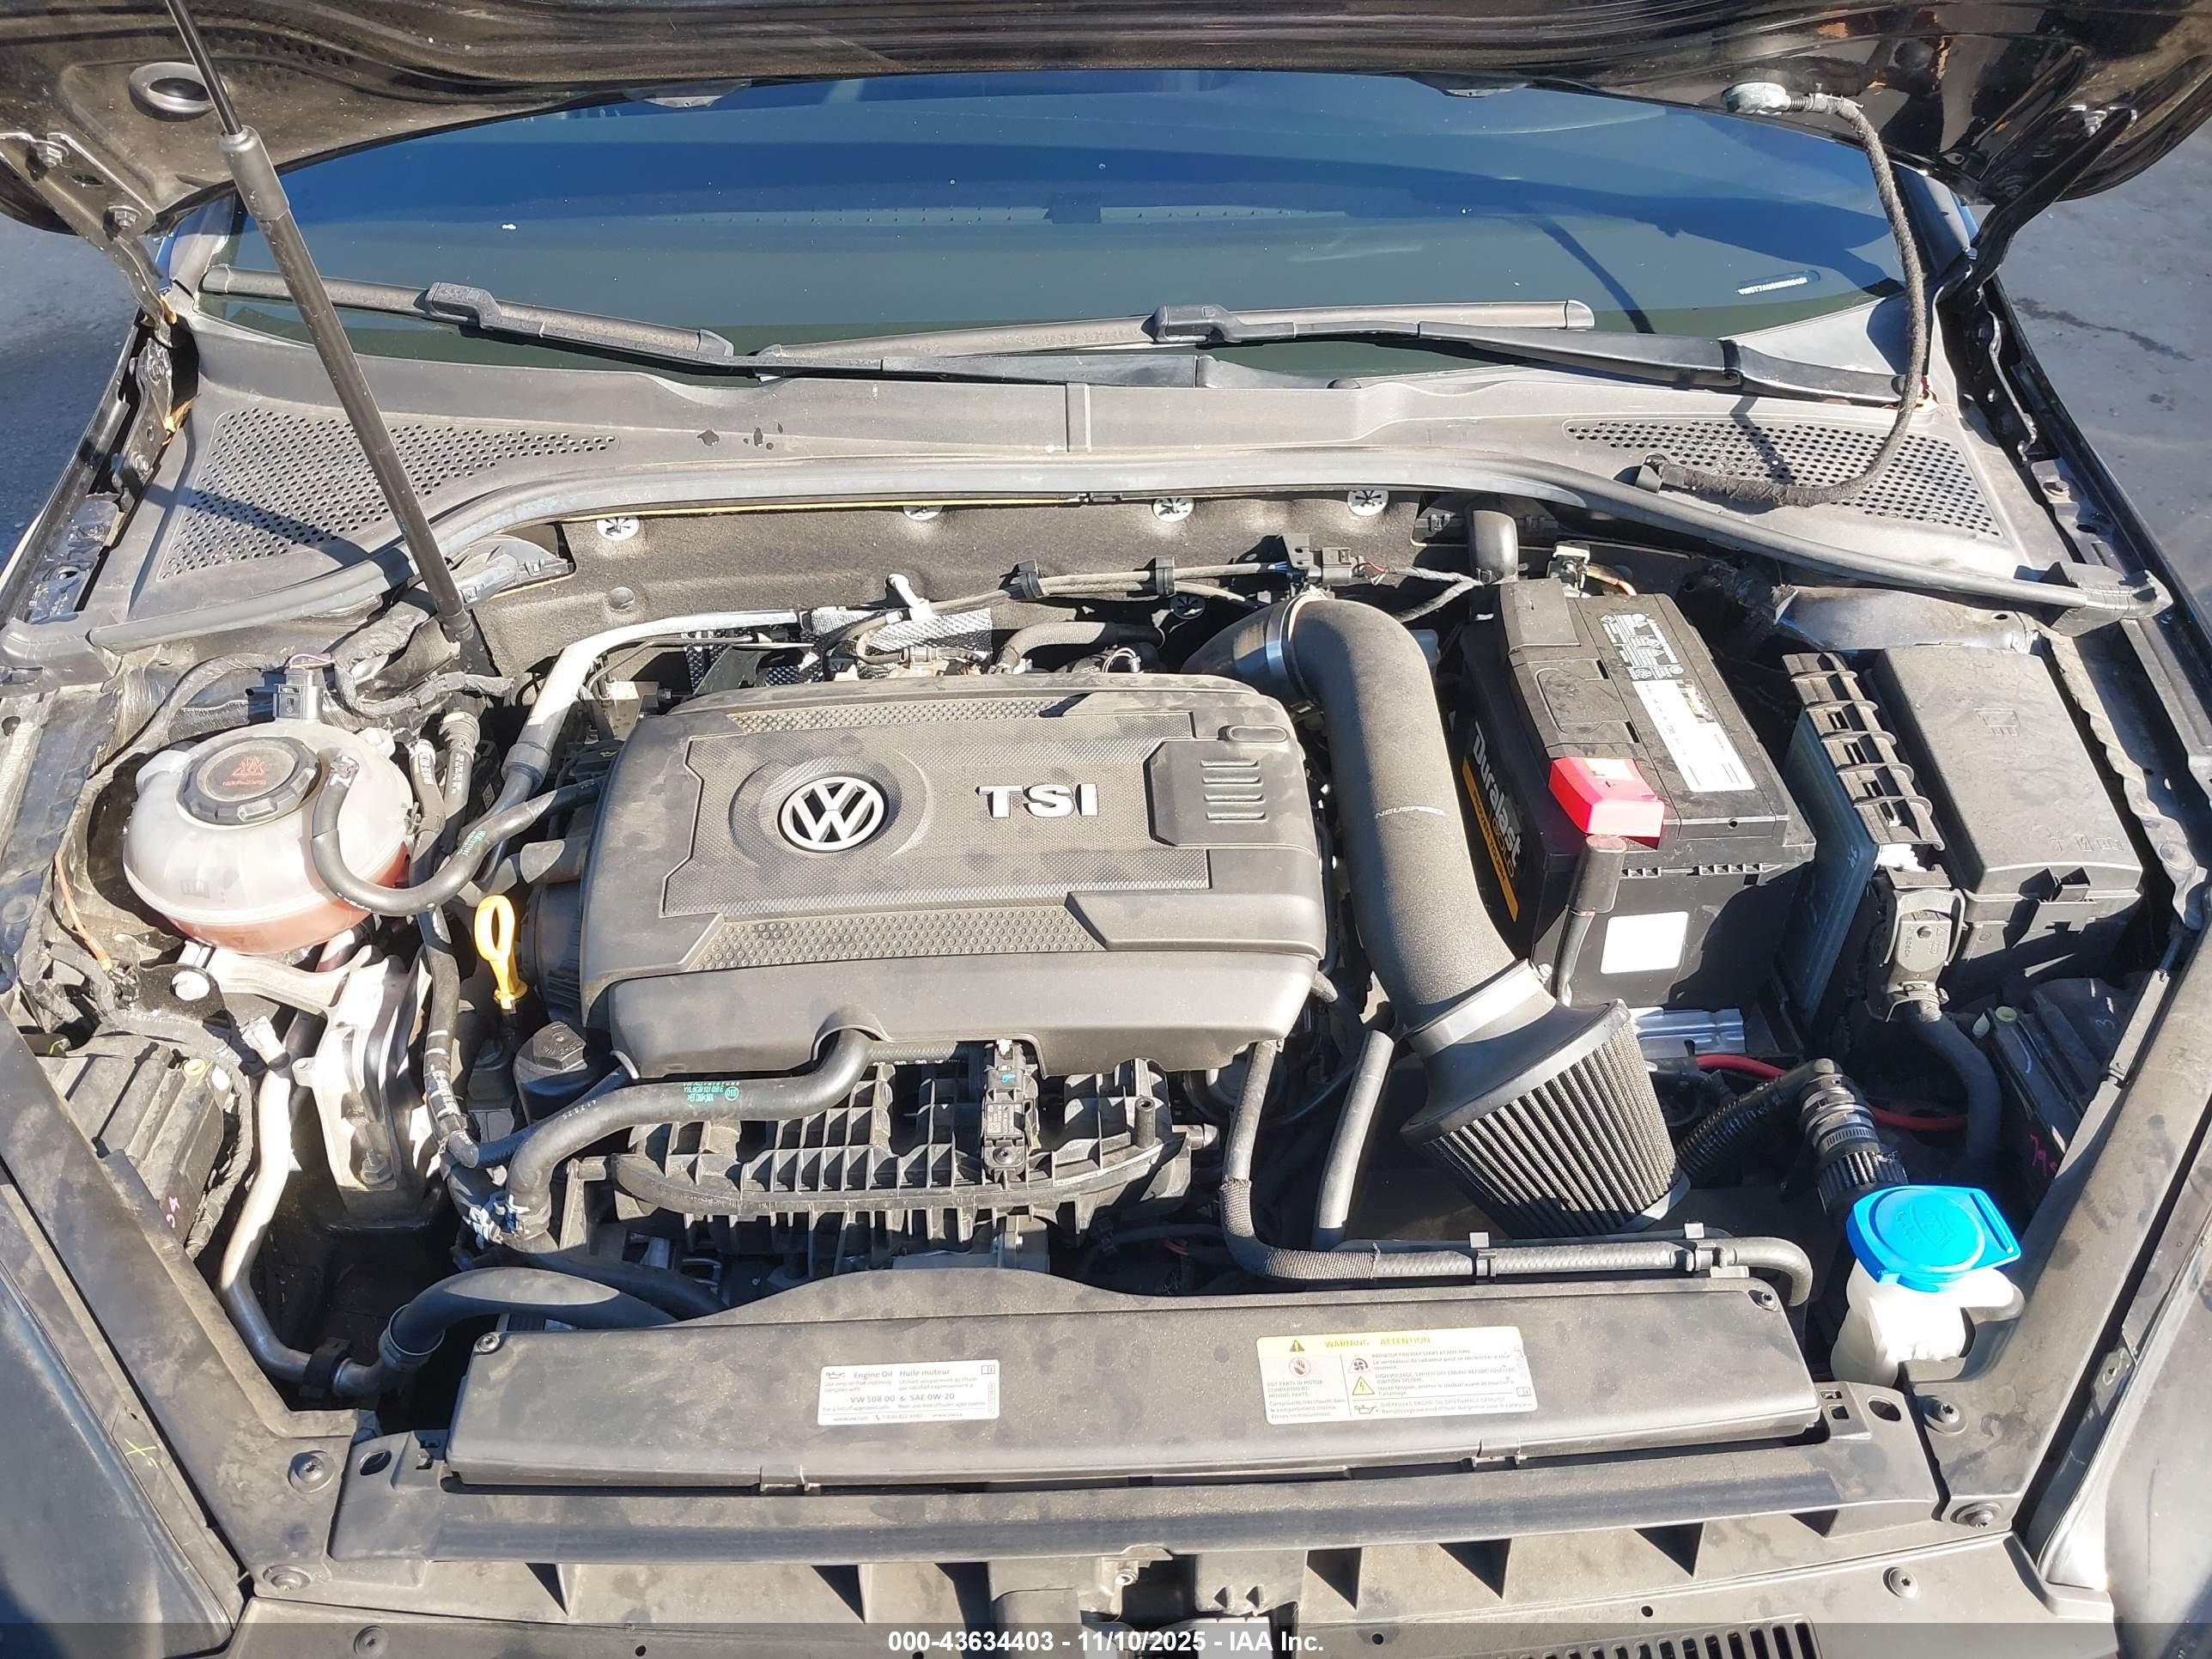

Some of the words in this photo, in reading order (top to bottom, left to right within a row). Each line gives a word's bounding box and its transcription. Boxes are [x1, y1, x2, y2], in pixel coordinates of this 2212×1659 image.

[975, 783, 1099, 818] TSI
[1473, 720, 1521, 868] Duralast
[854, 1371, 880, 1380] Engine
